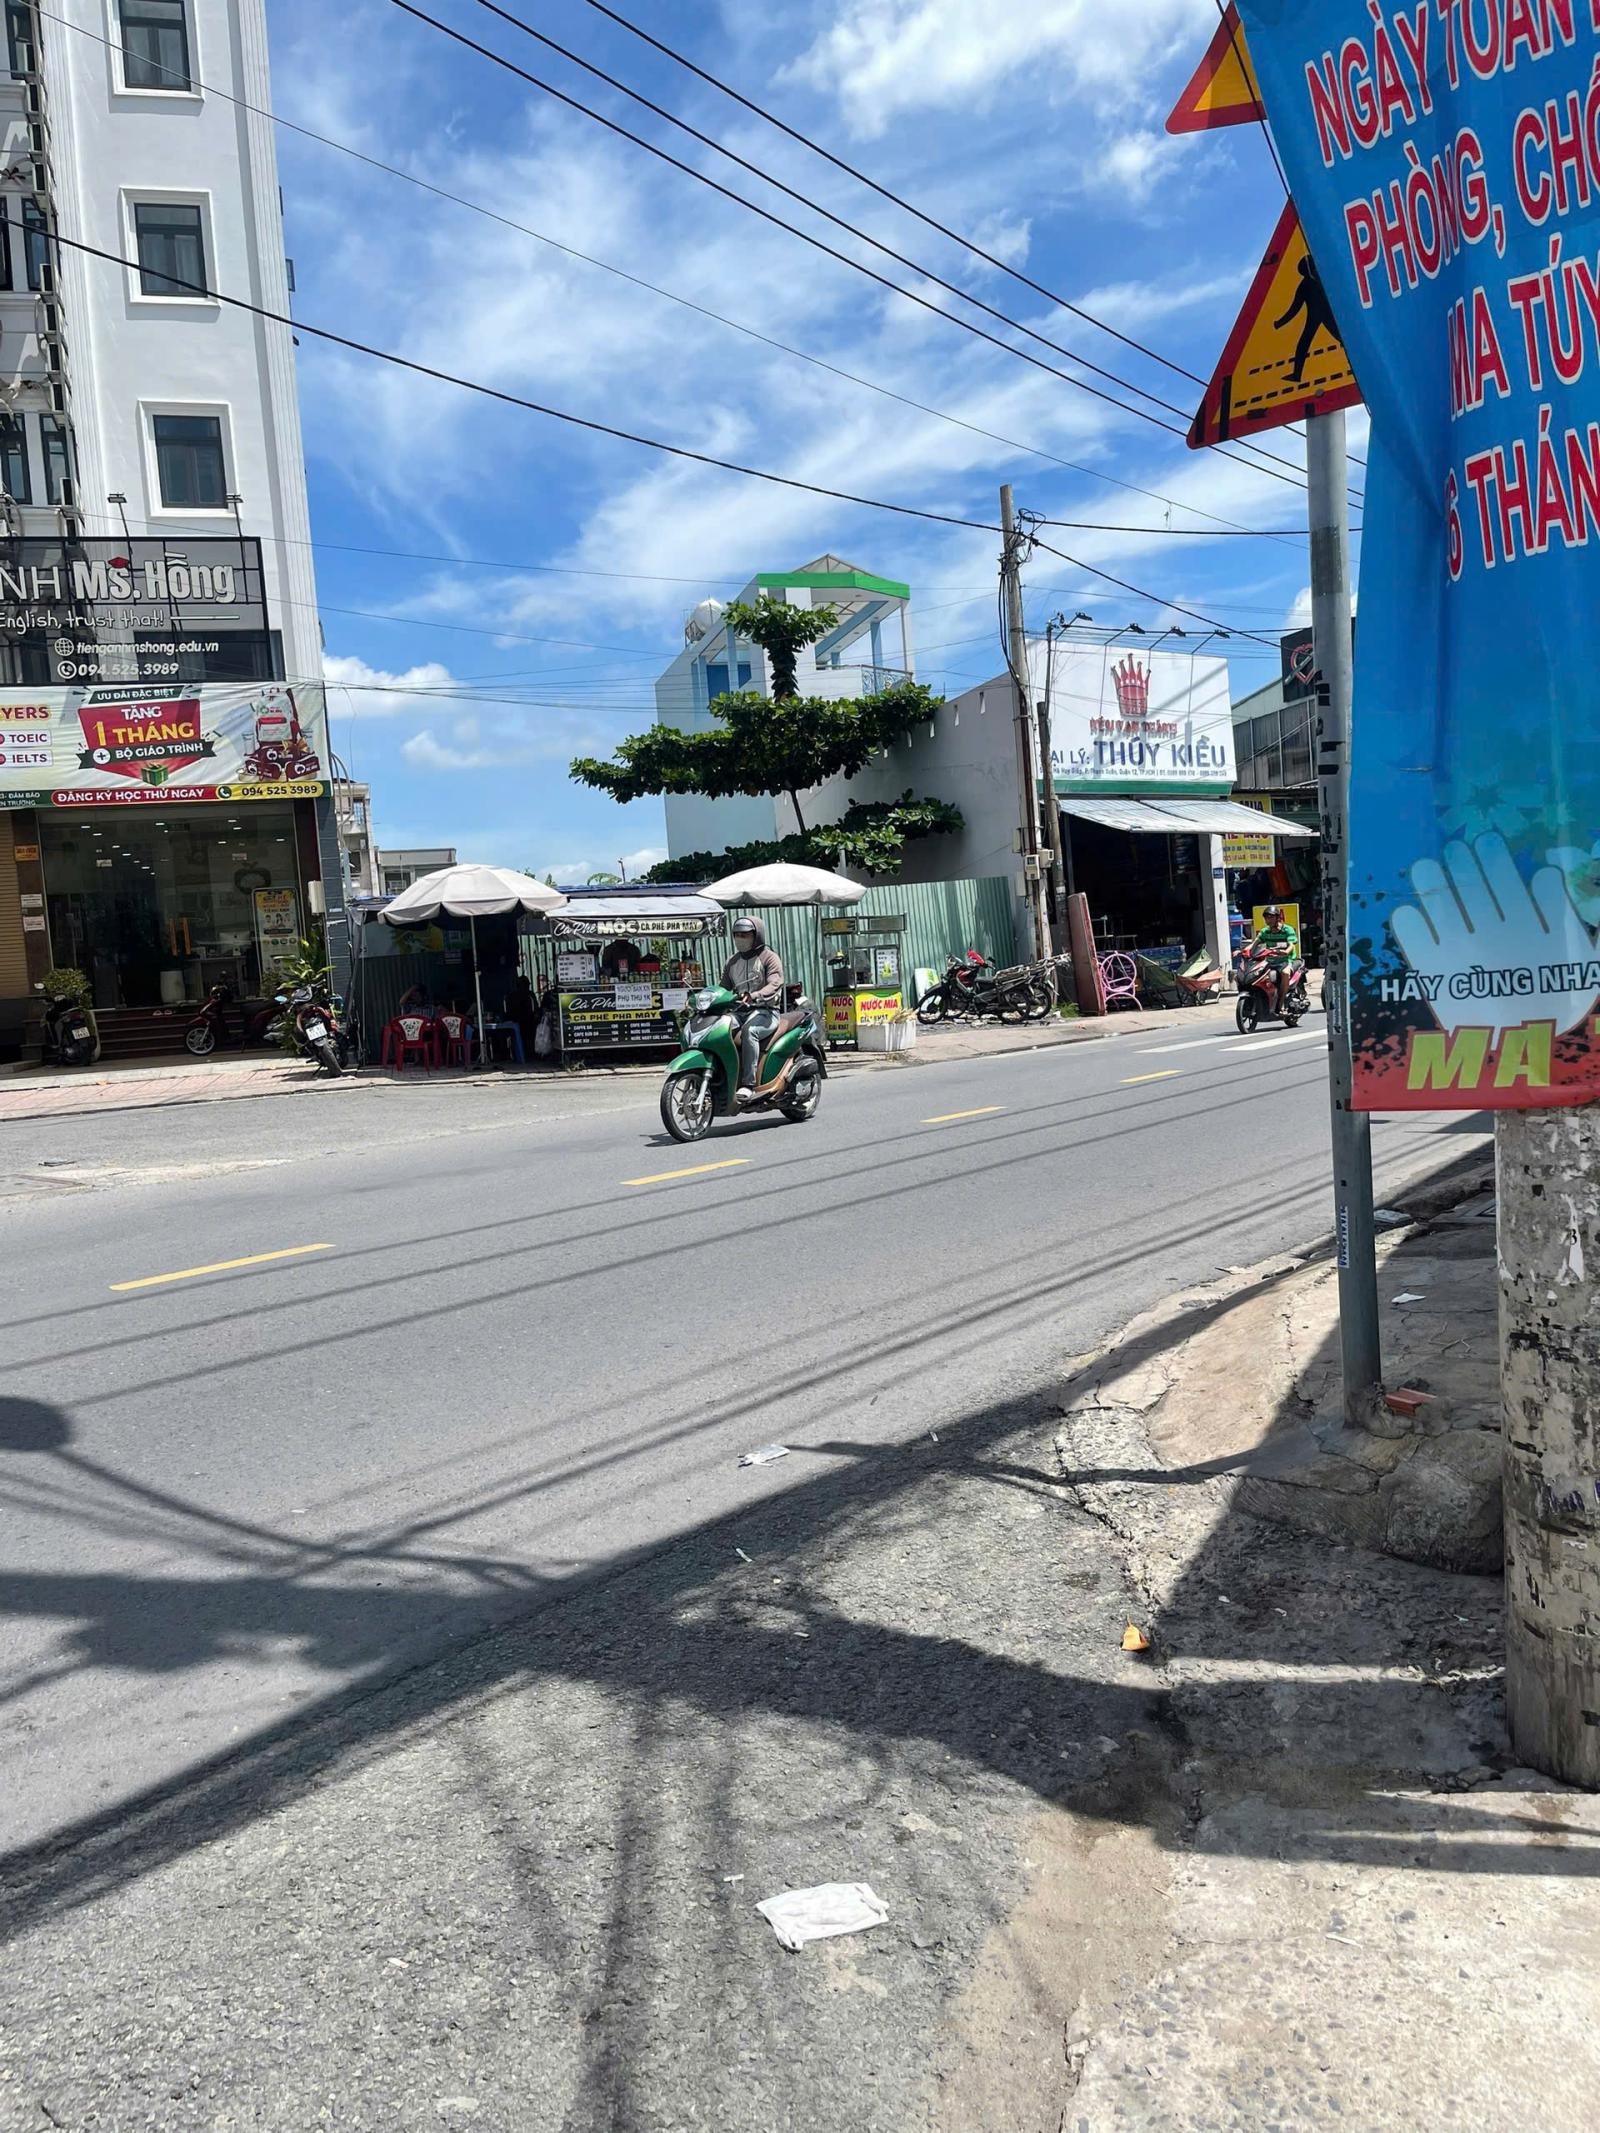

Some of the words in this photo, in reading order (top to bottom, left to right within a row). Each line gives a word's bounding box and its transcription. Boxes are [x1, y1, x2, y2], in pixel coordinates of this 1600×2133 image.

[1305, 2, 1434, 168] NGÀY
[1344, 126, 1507, 309] PHÒNG,
[1448, 285, 1511, 422] MA
[72, 559, 142, 600] Ms.
[144, 552, 236, 604] Hồng
[0, 609, 63, 635] English,
[65, 610, 116, 629] trust
[121, 608, 165, 628] that!
[78, 662, 180, 677] 094.525.3989
[154, 686, 175, 698] BIỆT
[121, 705, 163, 723] TẶNG
[9, 733, 48, 744] TOEIC
[92, 720, 107, 747] 1
[112, 721, 195, 745] THÁNG
[12, 753, 48, 764] IELTS
[115, 747, 133, 760] BỘ
[135, 745, 165, 757] GIÁO
[166, 742, 203, 755] TRÌNH
[1049, 749, 1064, 767] ẠI
[1070, 747, 1091, 765] LÝ:
[1093, 736, 1160, 767] THÚY
[1171, 735, 1226, 768] KIỀU
[57, 789, 94, 802] ĐĂNG
[115, 790, 142, 803] HỌC
[143, 786, 168, 799] THỬ
[170, 788, 205, 799] NGAY
[241, 786, 264, 797] 094
[266, 785, 288, 796] 525
[289, 784, 319, 795] 3989
[1380, 969, 1444, 1002] HÃY
[1448, 965, 1533, 1000] CÙNG
[1406, 1019, 1556, 1090] MA
